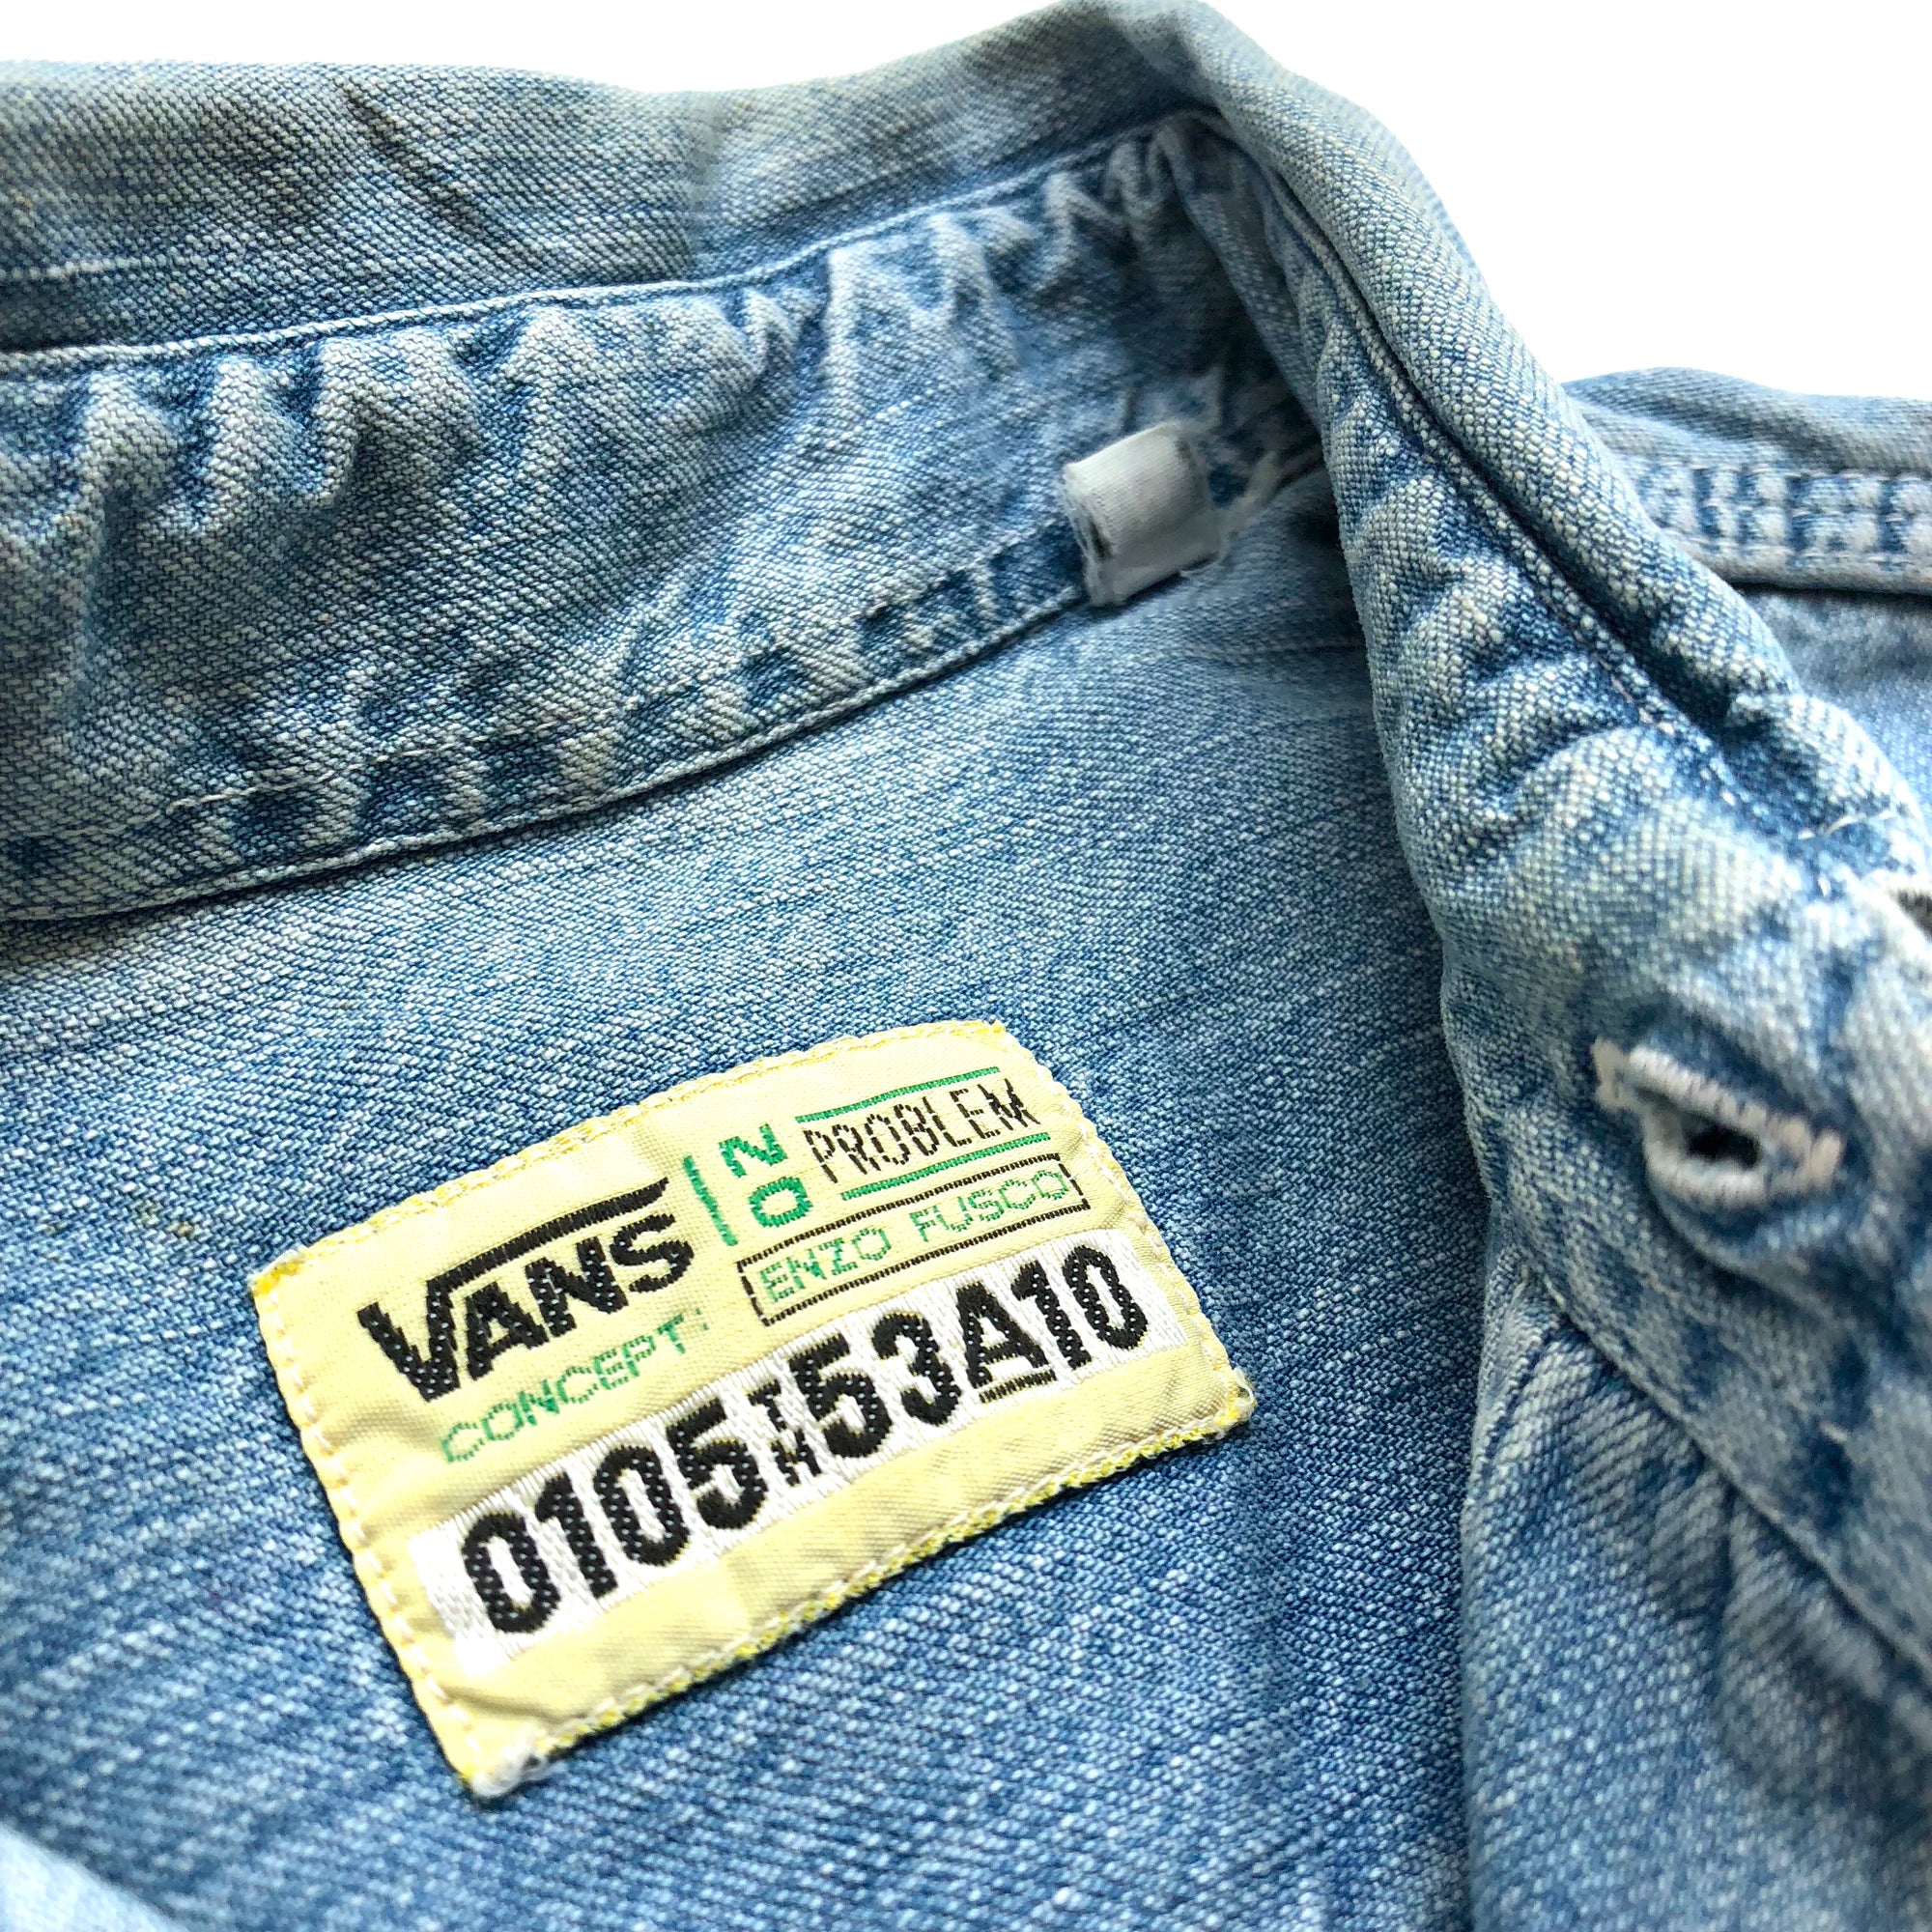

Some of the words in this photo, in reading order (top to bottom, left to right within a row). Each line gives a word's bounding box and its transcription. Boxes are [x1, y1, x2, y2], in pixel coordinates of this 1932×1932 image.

[803, 1077, 1041, 1184] PROBLEM
[356, 1177, 695, 1403] VANS
[758, 1226, 892, 1303] ENZO
[908, 1169, 1070, 1243] FUSCO
